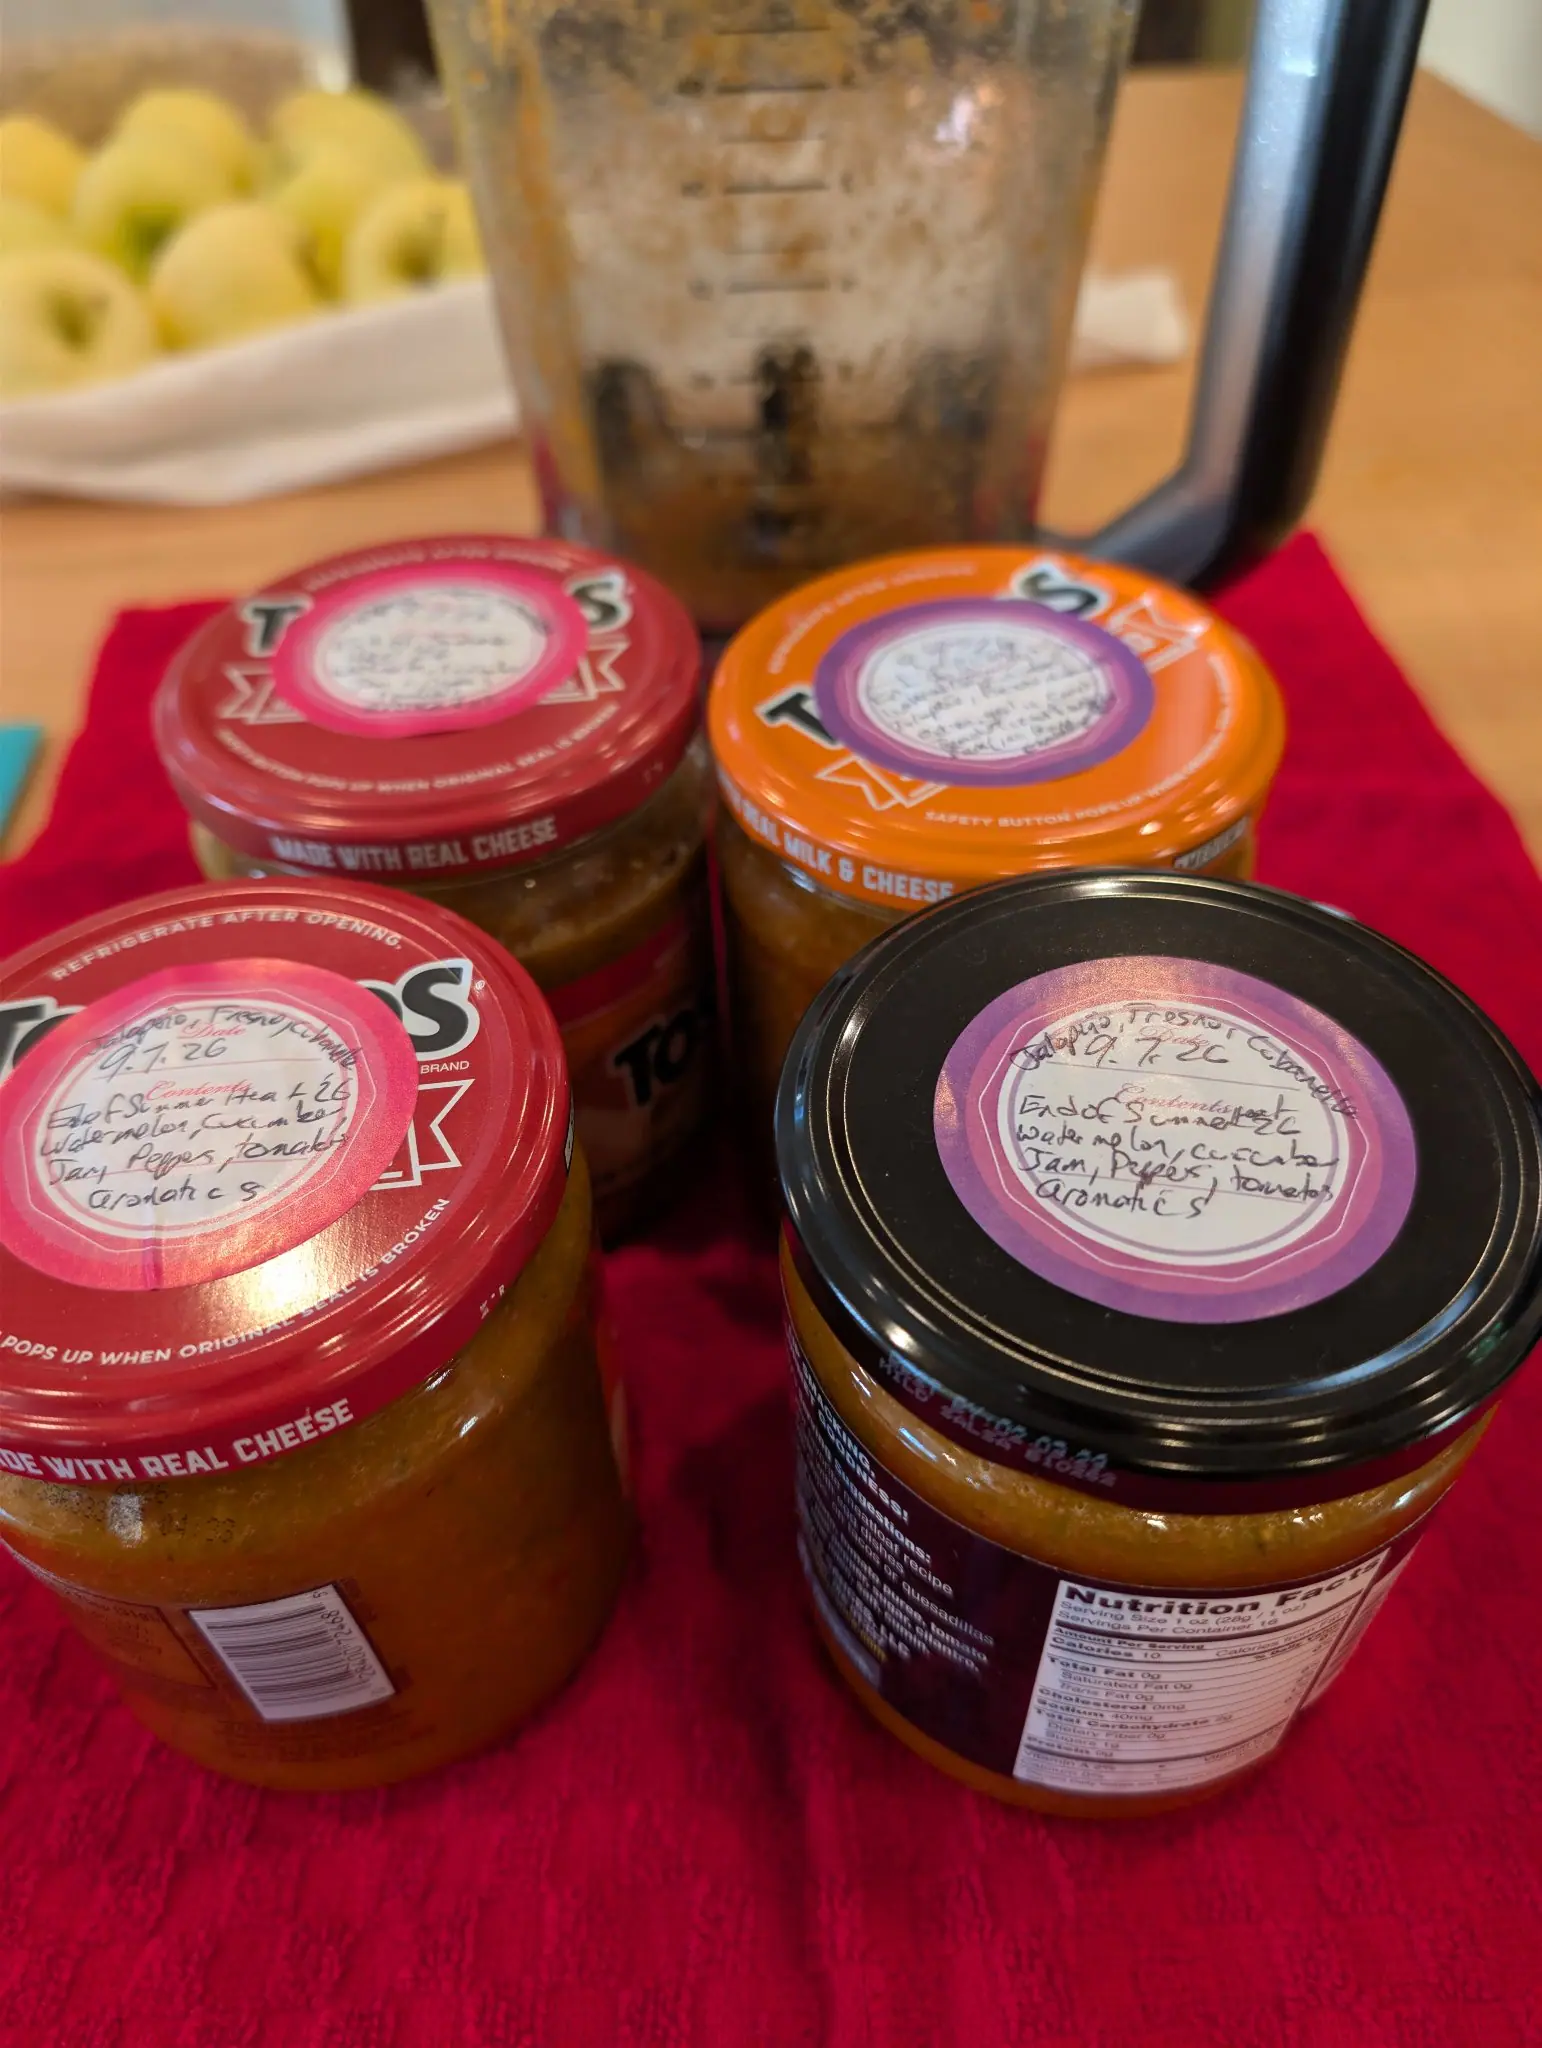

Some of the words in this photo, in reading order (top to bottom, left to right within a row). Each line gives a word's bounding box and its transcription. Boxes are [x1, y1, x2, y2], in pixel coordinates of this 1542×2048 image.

[999, 811, 1071, 828] BUTTON
[269, 835, 333, 868] MADE
[339, 843, 402, 871] WITH
[408, 834, 468, 871] REAL
[473, 814, 557, 862] CHEESE
[784, 830, 832, 874] MILK
[838, 858, 854, 882] &
[863, 866, 953, 903] CHEESE
[50, 914, 214, 981] REFRIGERATE
[221, 909, 298, 925] AFTER
[303, 909, 402, 950] OPENING,
[179, 1022, 247, 1041] Date
[420, 1060, 470, 1075] BRAND
[144, 1078, 254, 1101] Contents
[1, 1335, 58, 1361] POPS
[61, 1348, 94, 1364] UP
[98, 1347, 171, 1366] WHEN
[178, 1315, 296, 1359] ORIGINAL
[301, 1285, 357, 1318] SEAL
[357, 1266, 380, 1282] IS
[380, 1198, 450, 1266] BROKEN
[41, 1454, 137, 1481] WITH
[139, 1447, 229, 1479] REAL
[232, 1398, 354, 1463] CHEESE
[902, 1552, 954, 1599] recipe
[1065, 1585, 1260, 1616] Nutrition
[1275, 1557, 1382, 1607] Facts
[1058, 1609, 1131, 1632] Servings
[1137, 1624, 1168, 1634] Per
[1172, 1622, 1253, 1635] Container
[1060, 1600, 1126, 1621] Serving
[1131, 1613, 1168, 1625] Size
[1052, 1636, 1134, 1659] Calories
[1048, 1655, 1097, 1674] Total
[1104, 1666, 1135, 1678] Fat
[1060, 1669, 1139, 1690] Saturated
[1144, 1682, 1170, 1690] Fat
[1039, 1687, 1147, 1710] Cholesterol
[1105, 1691, 1131, 1700] Fat
[1087, 1718, 1210, 1731] Carbohydrate
